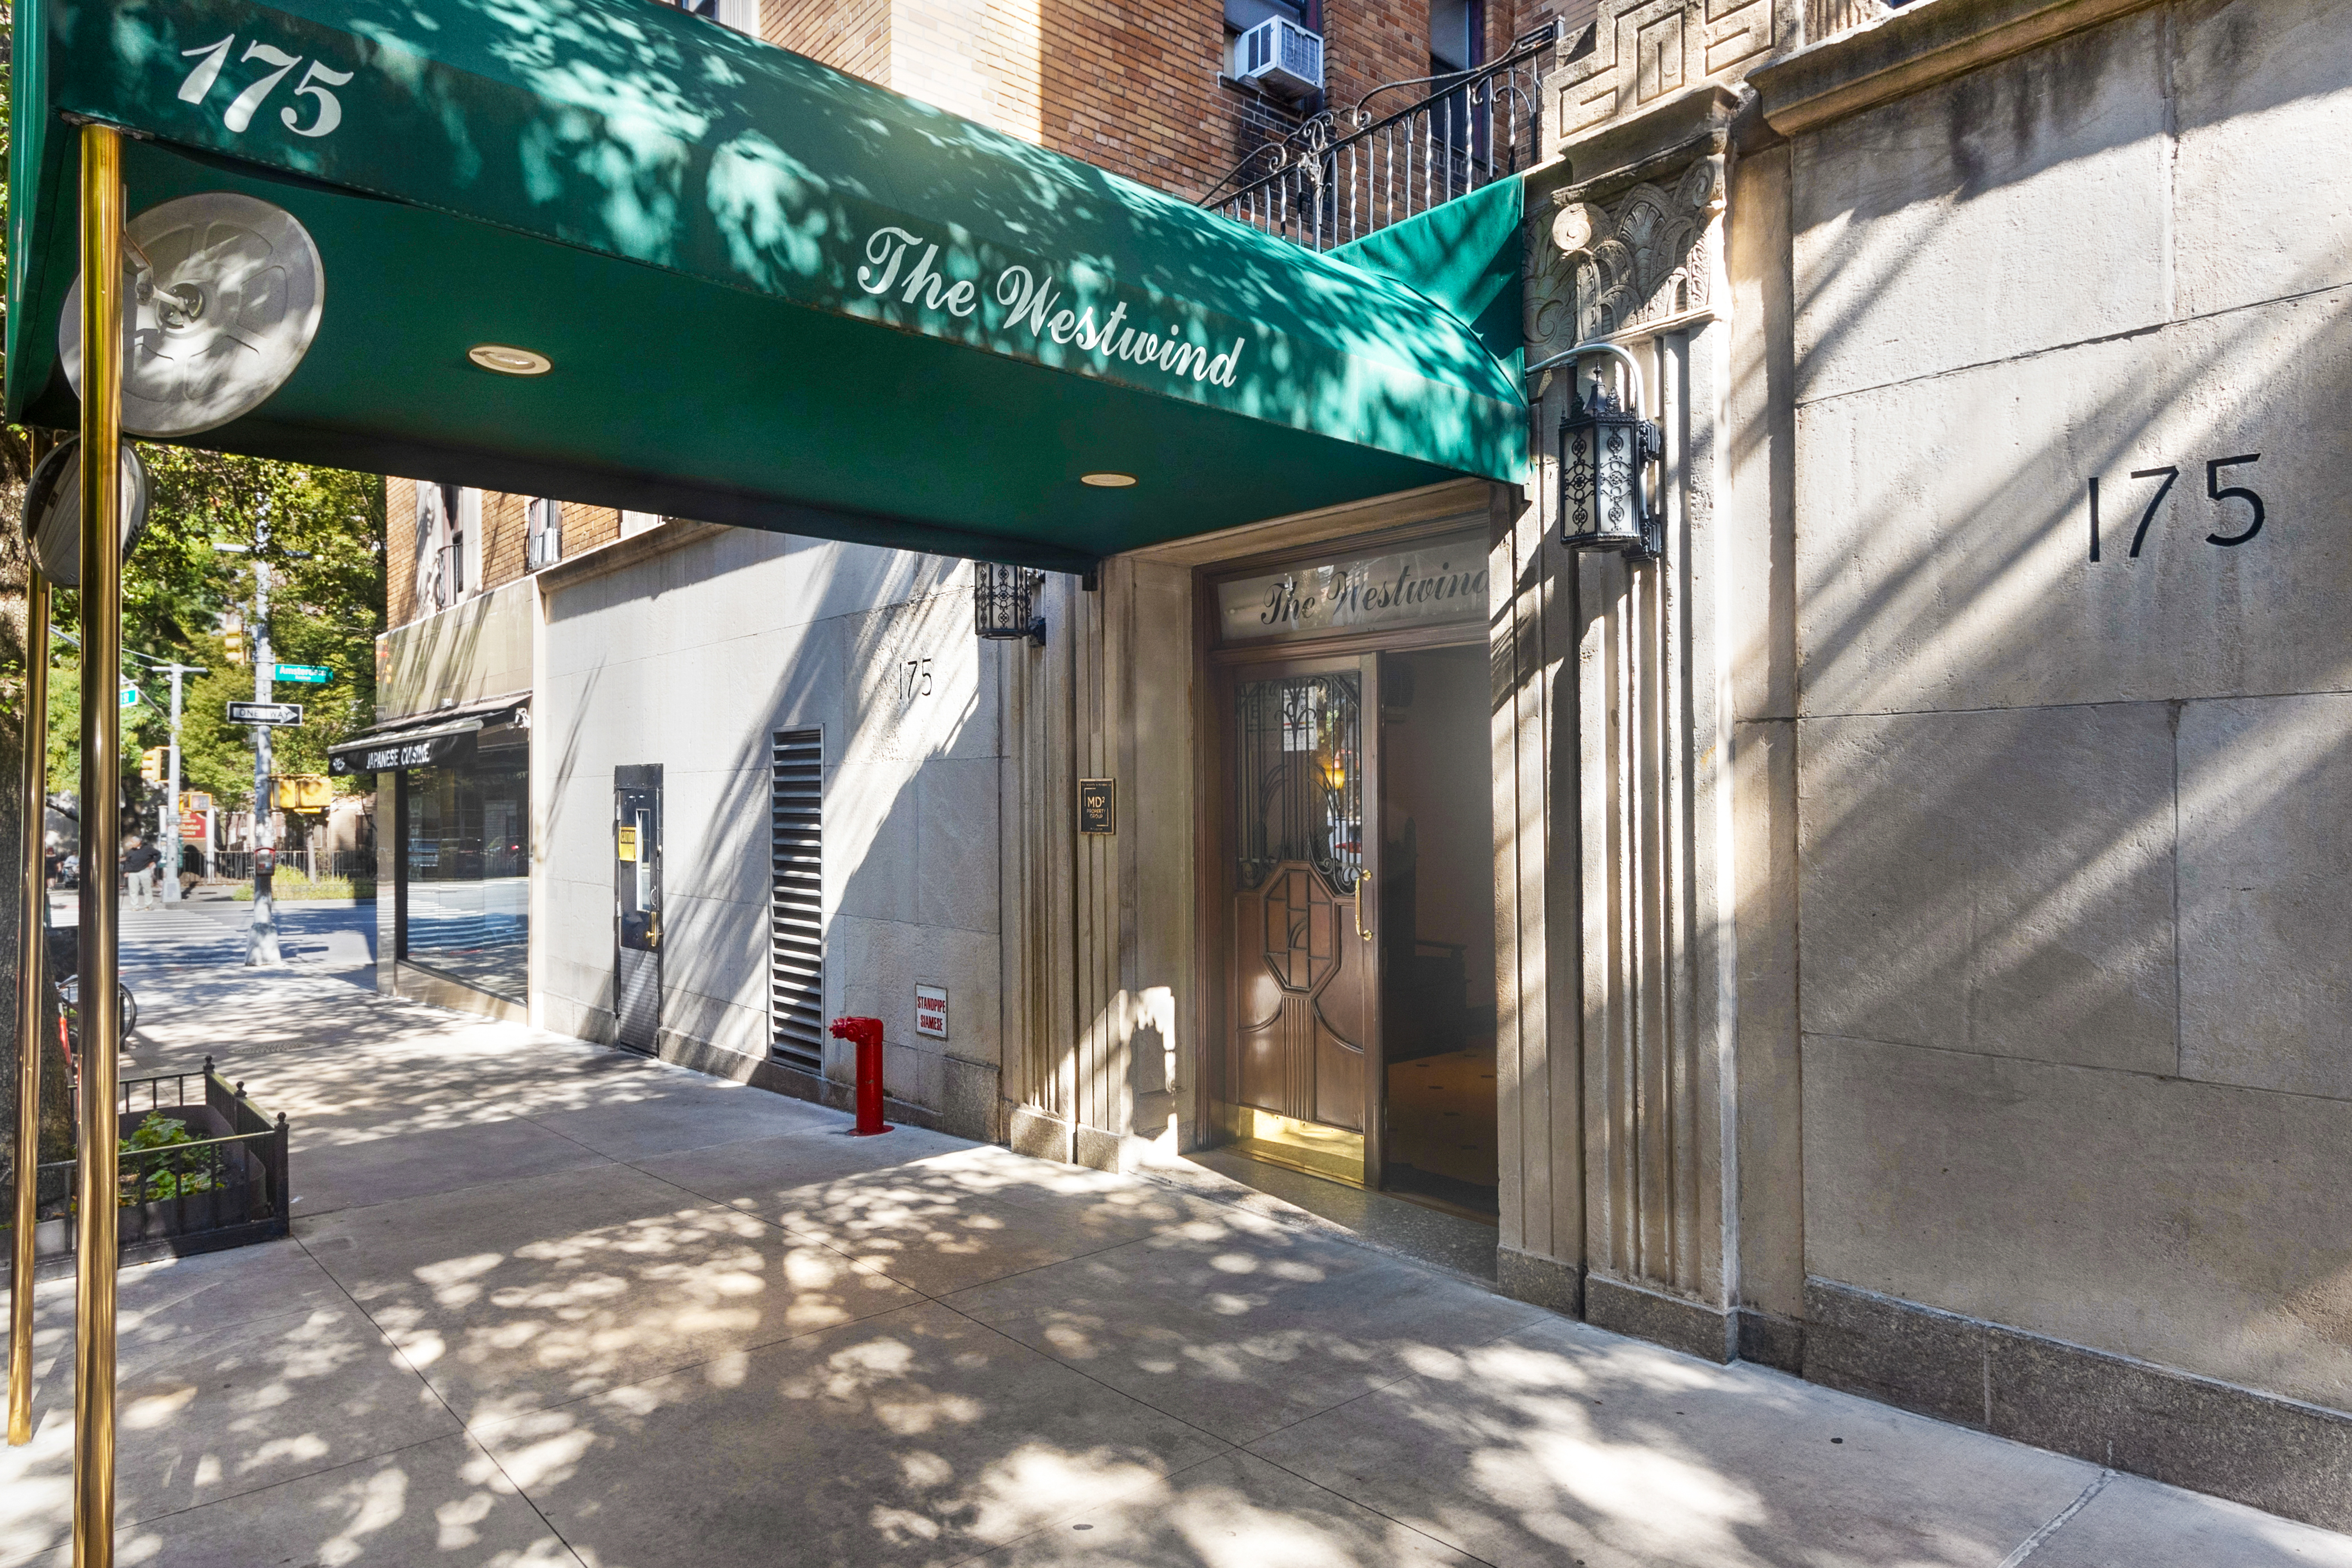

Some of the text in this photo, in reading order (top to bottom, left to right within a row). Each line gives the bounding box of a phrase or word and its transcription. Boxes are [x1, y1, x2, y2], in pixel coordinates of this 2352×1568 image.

[178, 33, 354, 137] 175
[857, 227, 1245, 388] The Westwind
[2088, 453, 2265, 562] 175
[1261, 582, 1315, 625] The
[900, 659, 932, 699] 175
[239, 709, 290, 719] ONE WAY
[367, 748, 399, 769] JAPANESE
[401, 743, 430, 765] CUISINE
[918, 996, 946, 1013] STANDPIPE
[920, 1014, 943, 1031] SIAMESE
